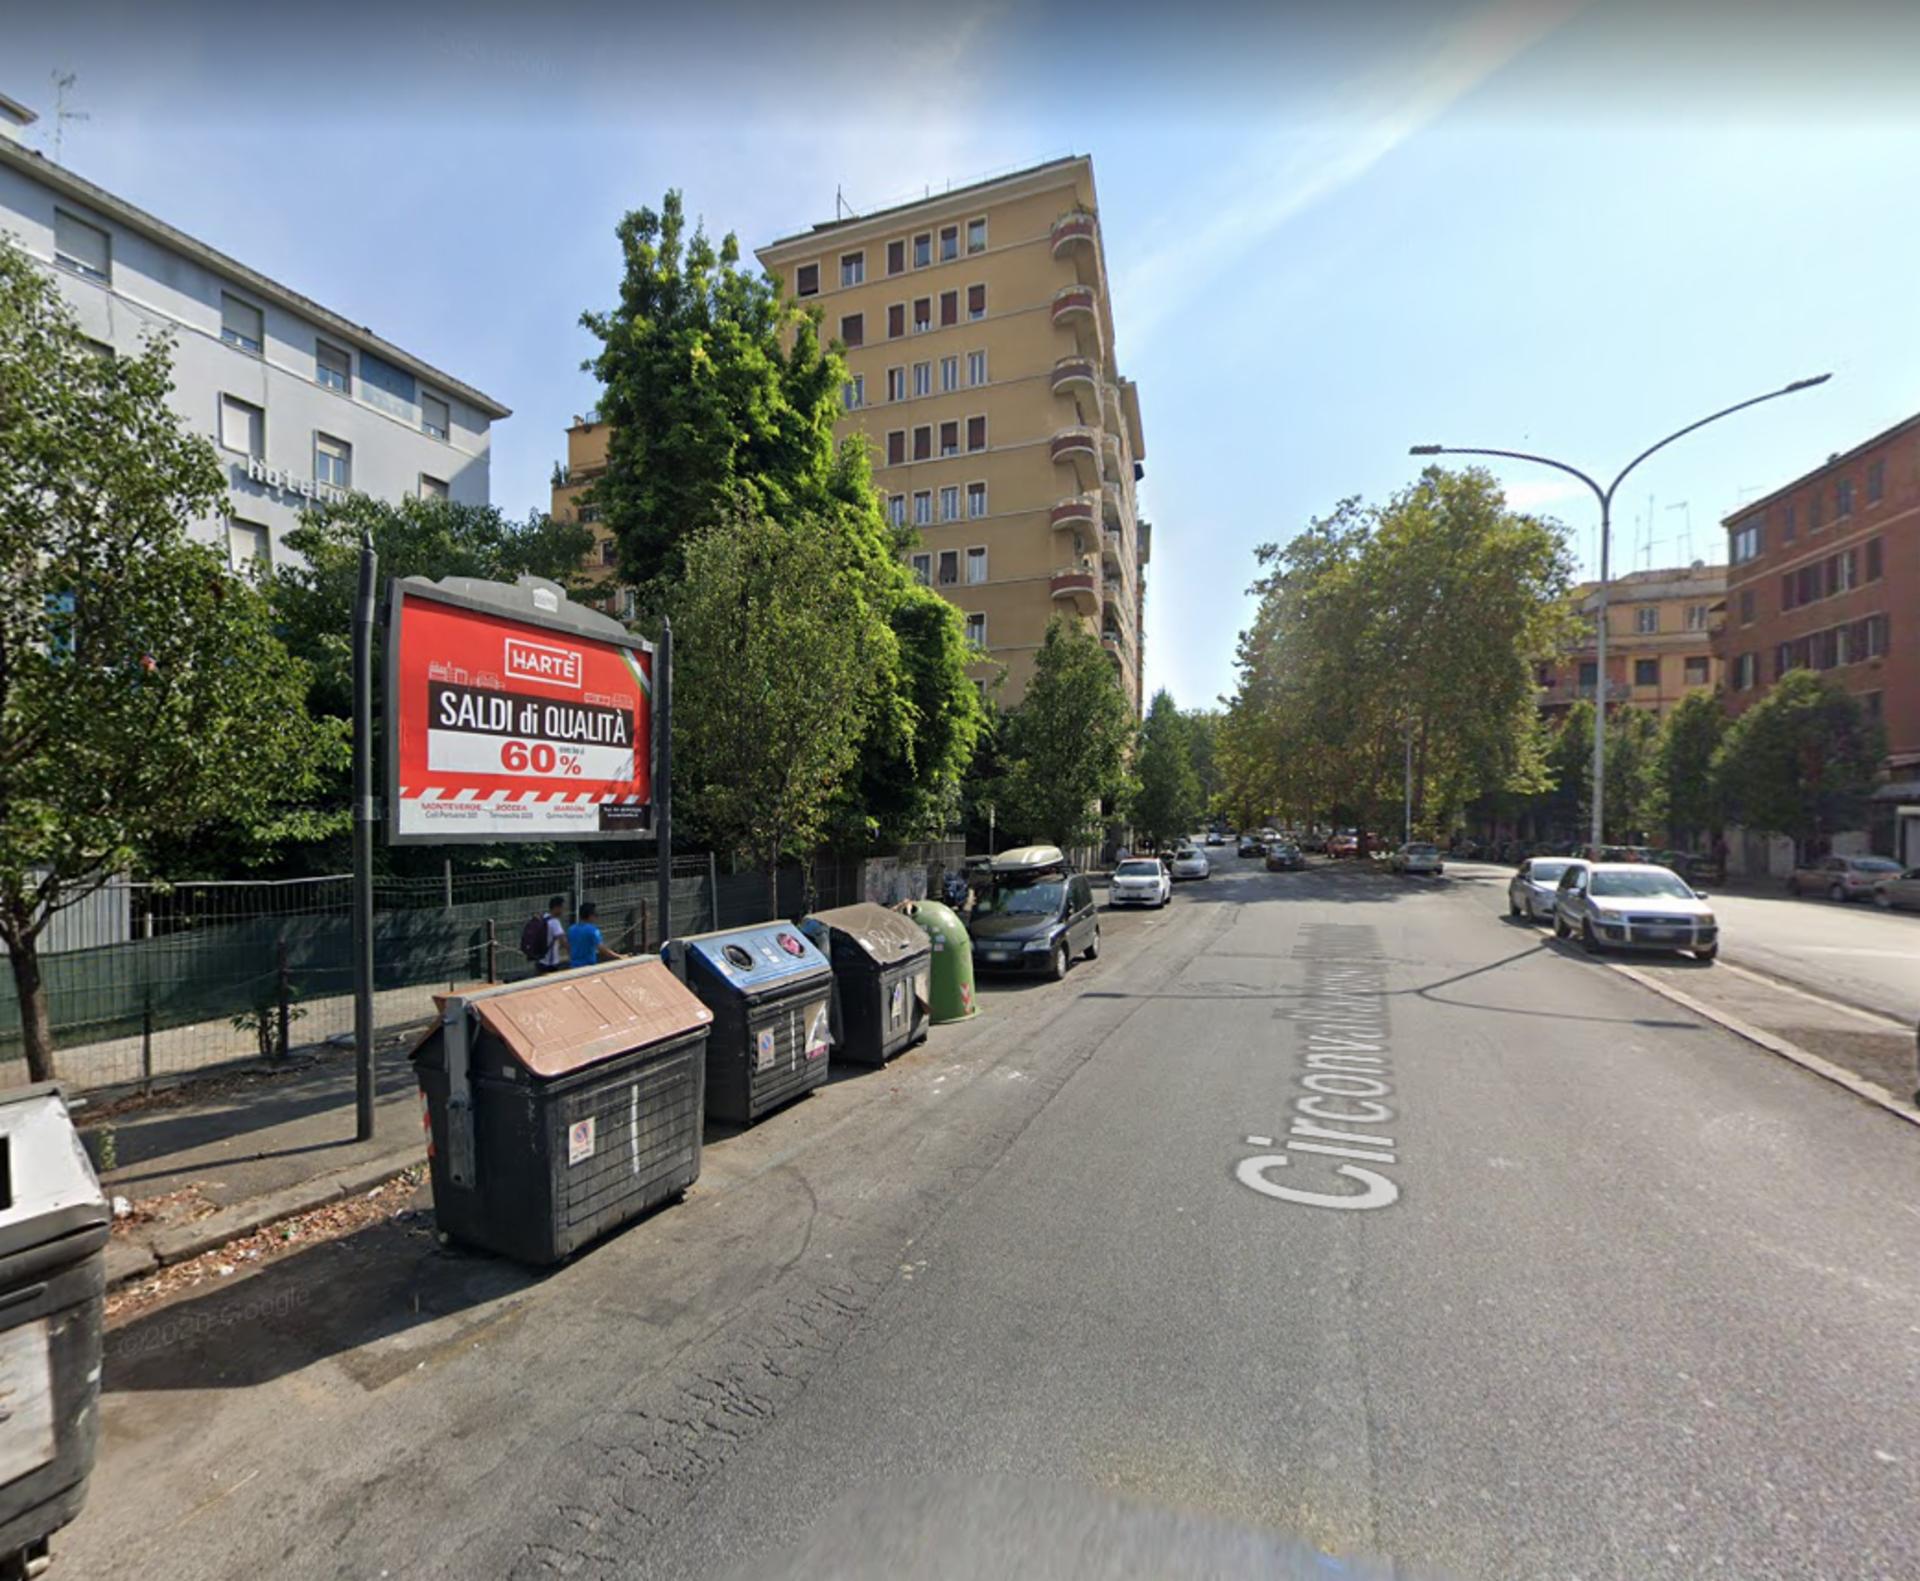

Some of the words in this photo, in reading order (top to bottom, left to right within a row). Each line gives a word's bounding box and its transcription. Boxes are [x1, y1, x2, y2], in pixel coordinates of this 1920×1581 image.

[248, 454, 320, 500] hotel
[440, 691, 513, 732] SALDI
[520, 703, 538, 734] di
[545, 707, 627, 744] QUALITÀ
